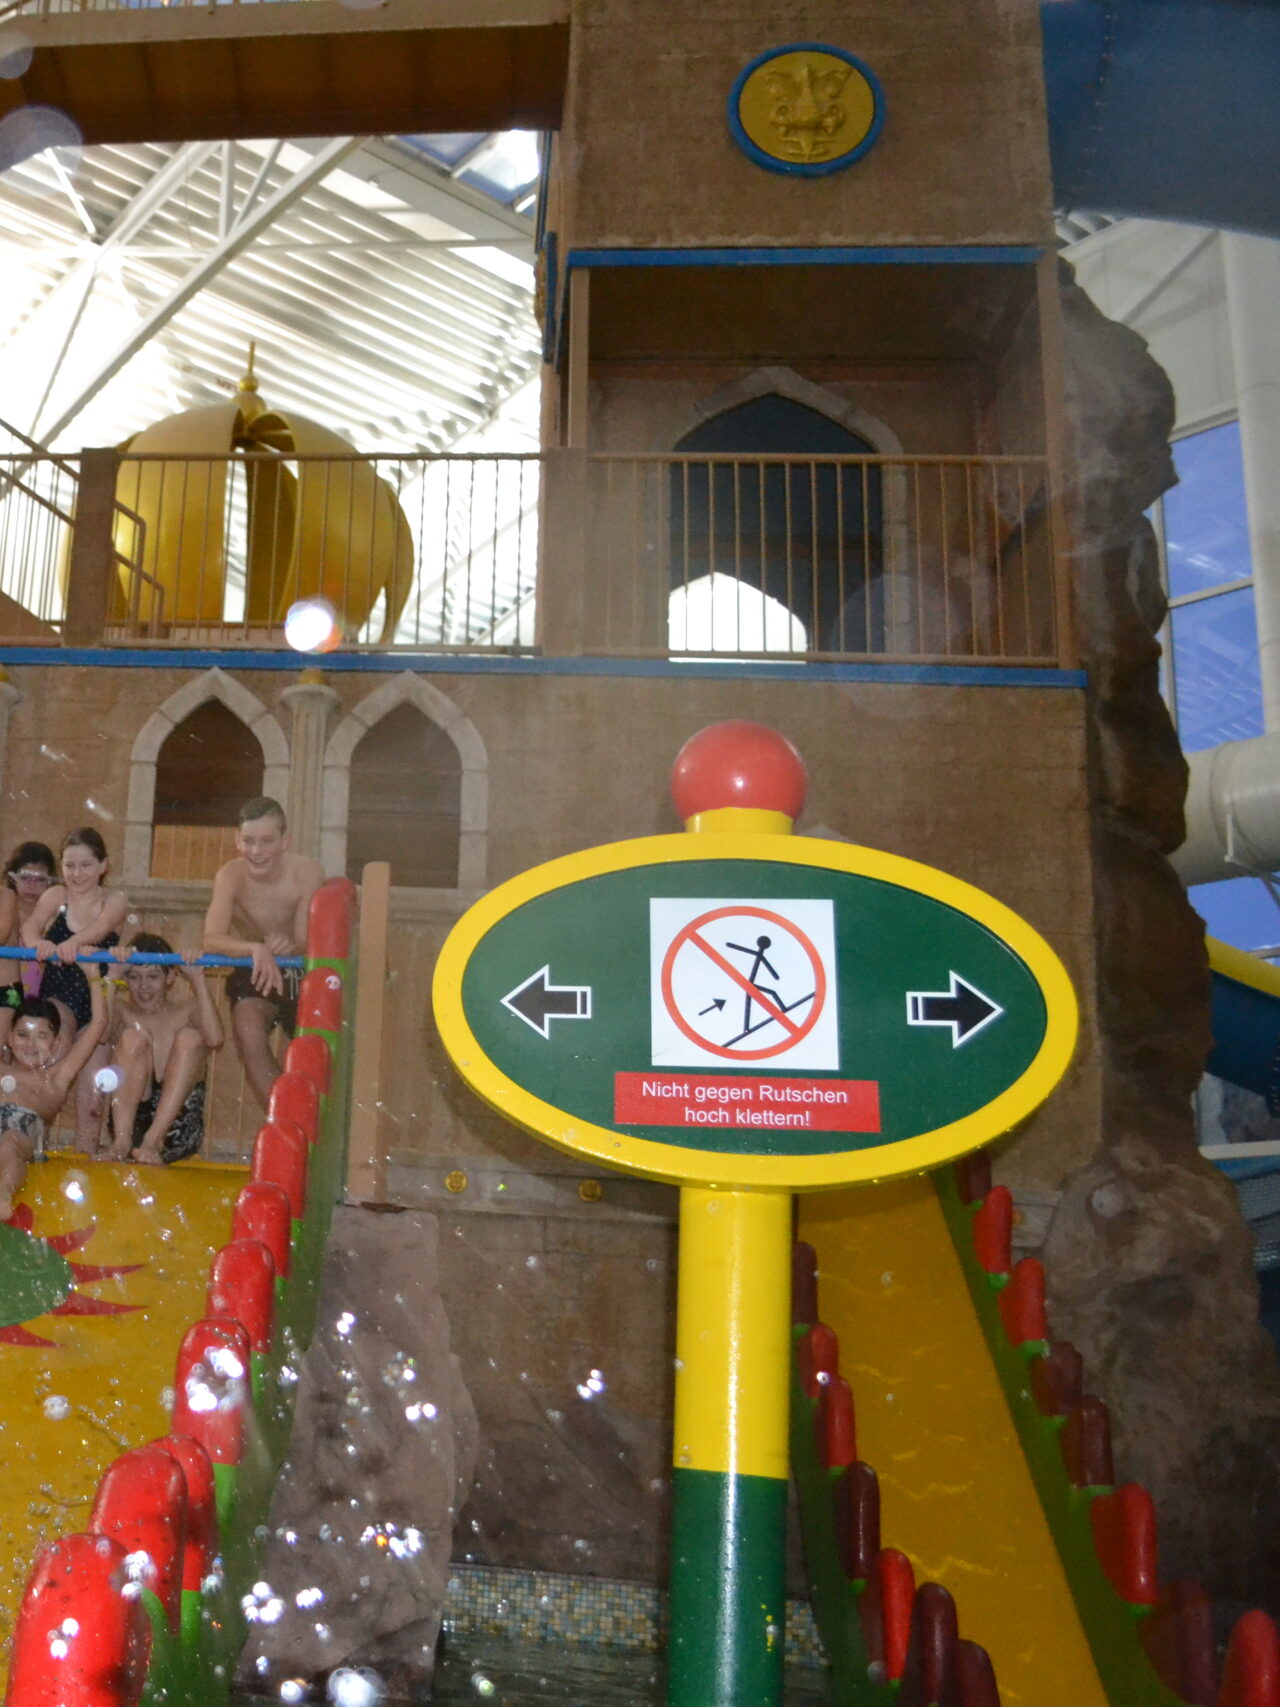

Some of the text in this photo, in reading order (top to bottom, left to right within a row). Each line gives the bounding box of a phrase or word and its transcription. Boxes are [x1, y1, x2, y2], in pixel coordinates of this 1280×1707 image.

[642, 1080, 848, 1104] Nicht gegen Rutschen
[684, 1105, 811, 1127] hoch klettern!
